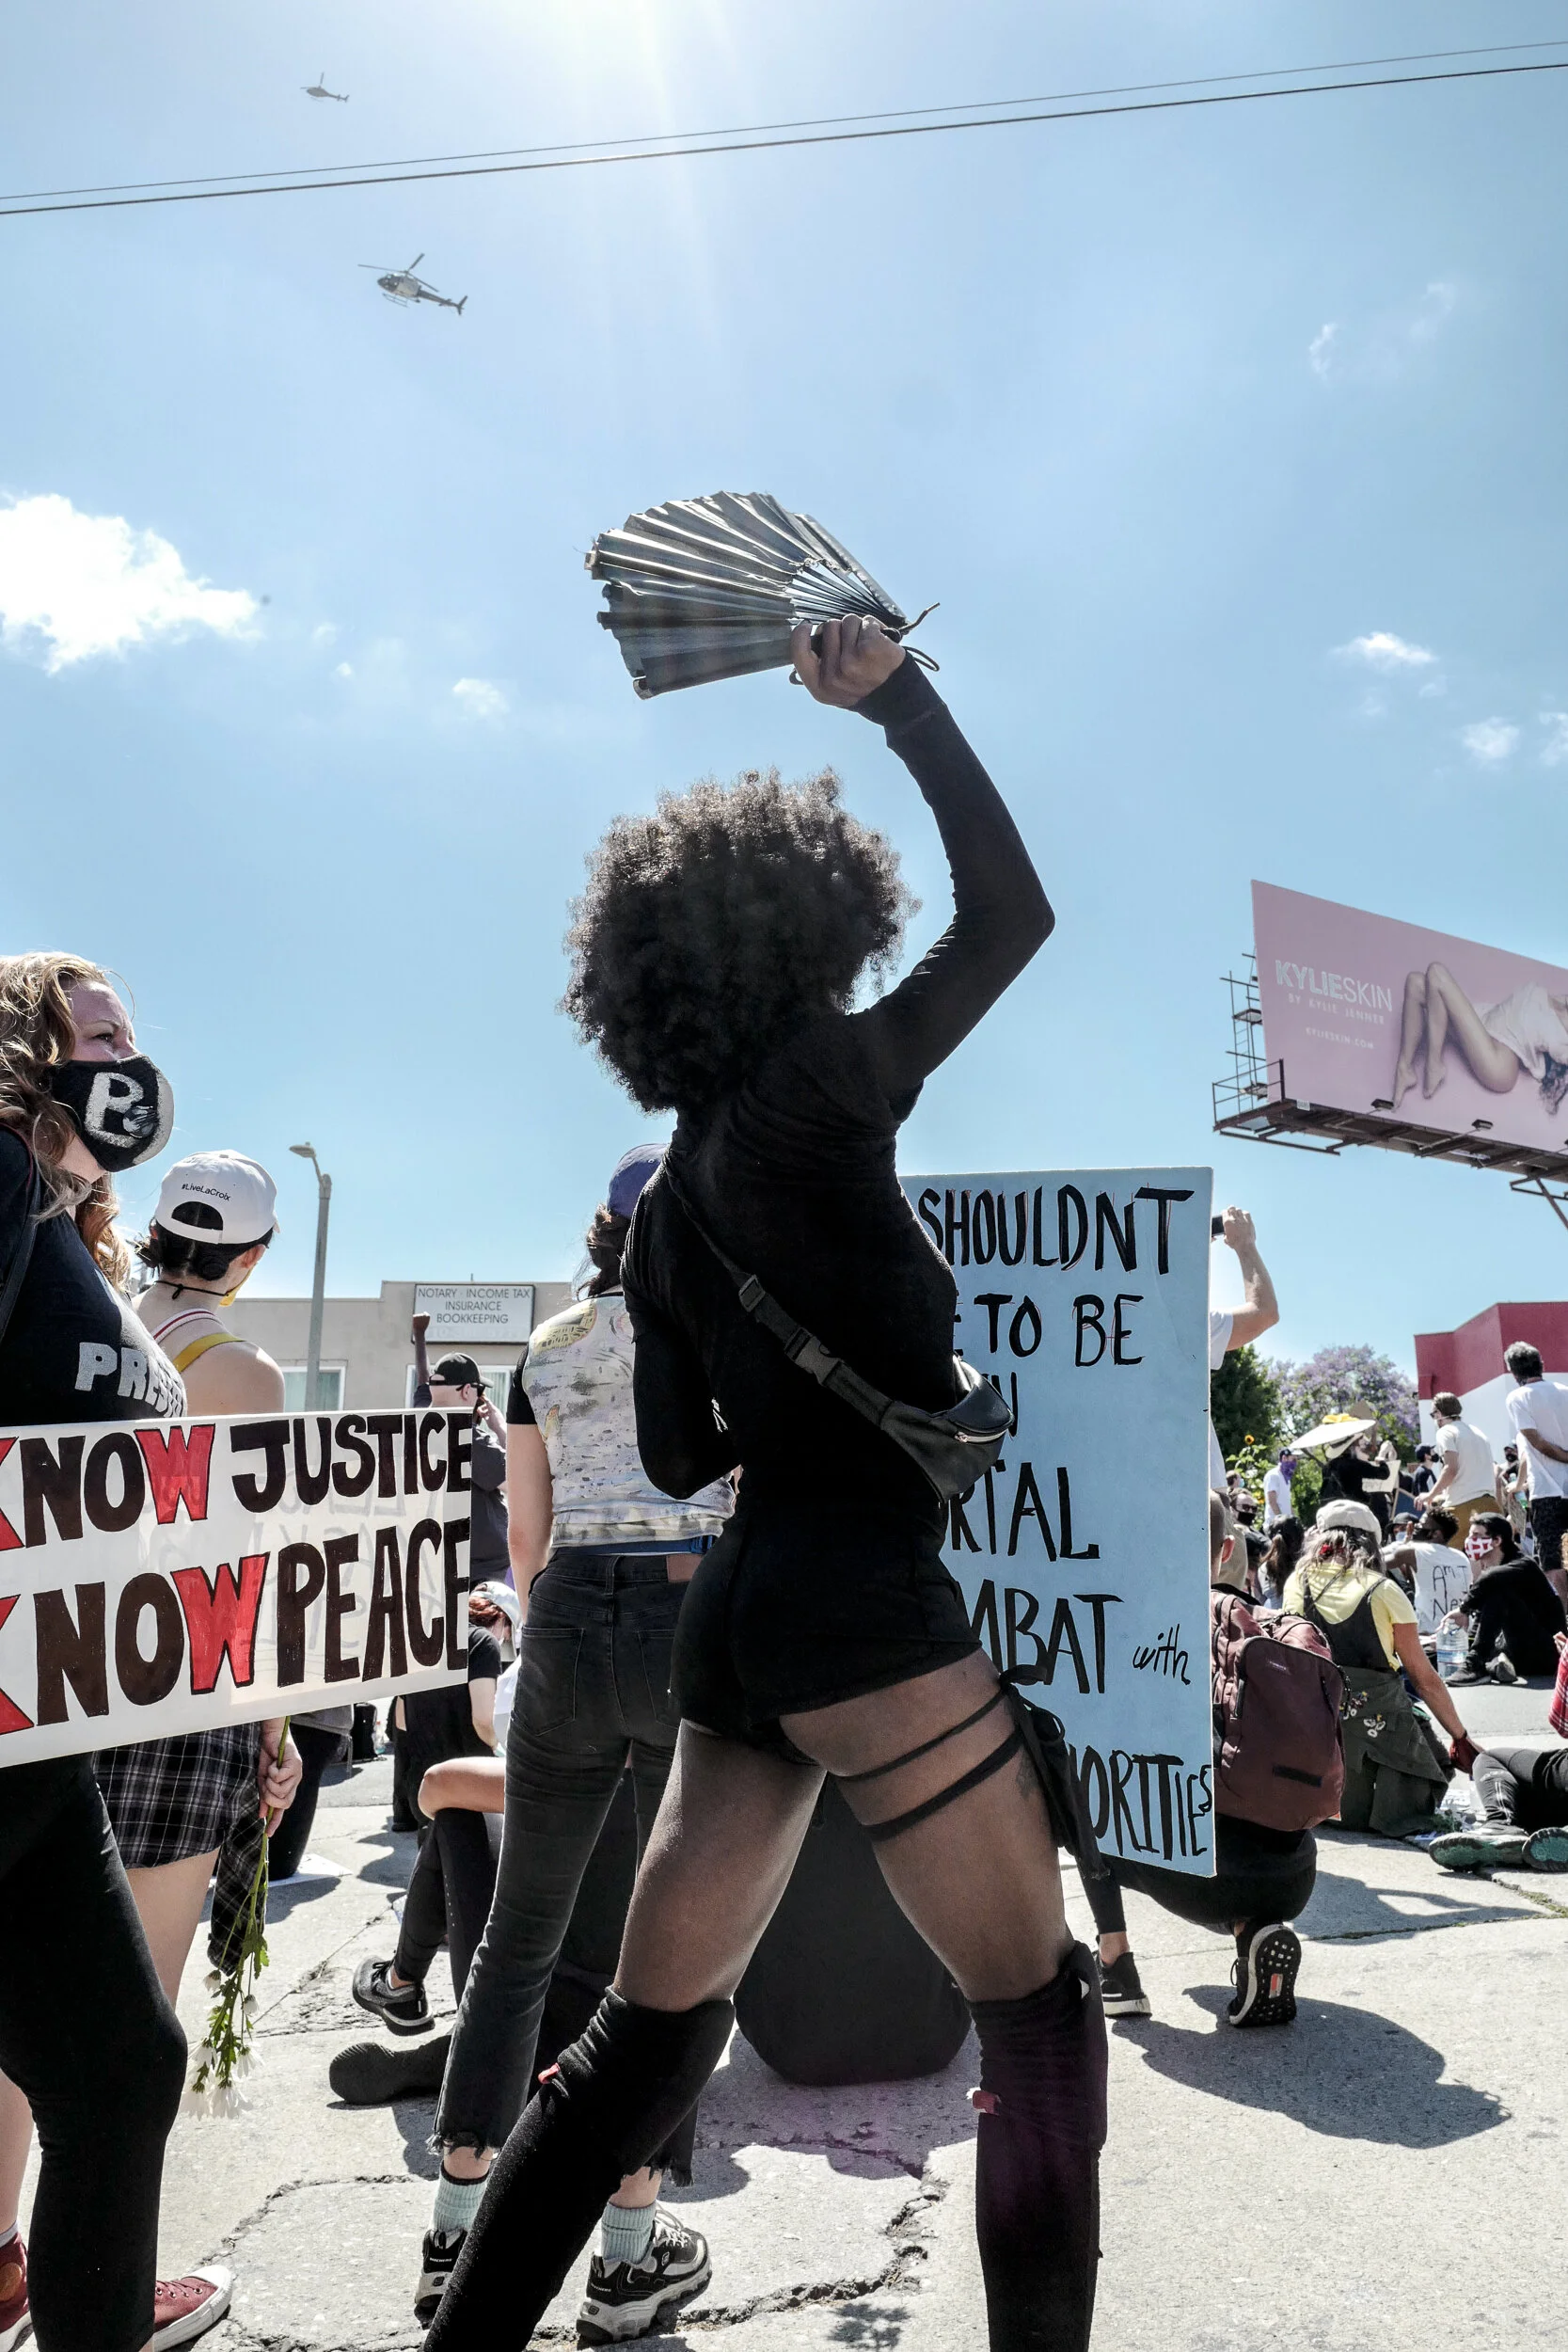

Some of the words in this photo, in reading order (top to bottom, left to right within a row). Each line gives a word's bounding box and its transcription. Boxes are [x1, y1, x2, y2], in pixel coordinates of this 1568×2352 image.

[1275, 960, 1392, 1012] KYLIESKIN
[1288, 993, 1301, 1006] BY
[1308, 998, 1338, 1014] KYLIE
[182, 1183, 231, 1201] #LiveLaCroix
[918, 1184, 1195, 1275] SHOULDNT
[418, 1288, 457, 1298] NOTARY
[467, 1289, 509, 1298] INCOME
[514, 1289, 531, 1298] TAX
[445, 1300, 502, 1311] INSURANCE
[436, 1312, 509, 1324] BOOKKEEPING
[974, 1293, 1042, 1358] TO
[1073, 1294, 1145, 1367] BE
[230, 1411, 473, 1514] JUSTICE
[277, 1517, 471, 1689] PEACE
[1432, 1597, 1464, 1621] Ne
[1132, 1624, 1192, 1685] with
